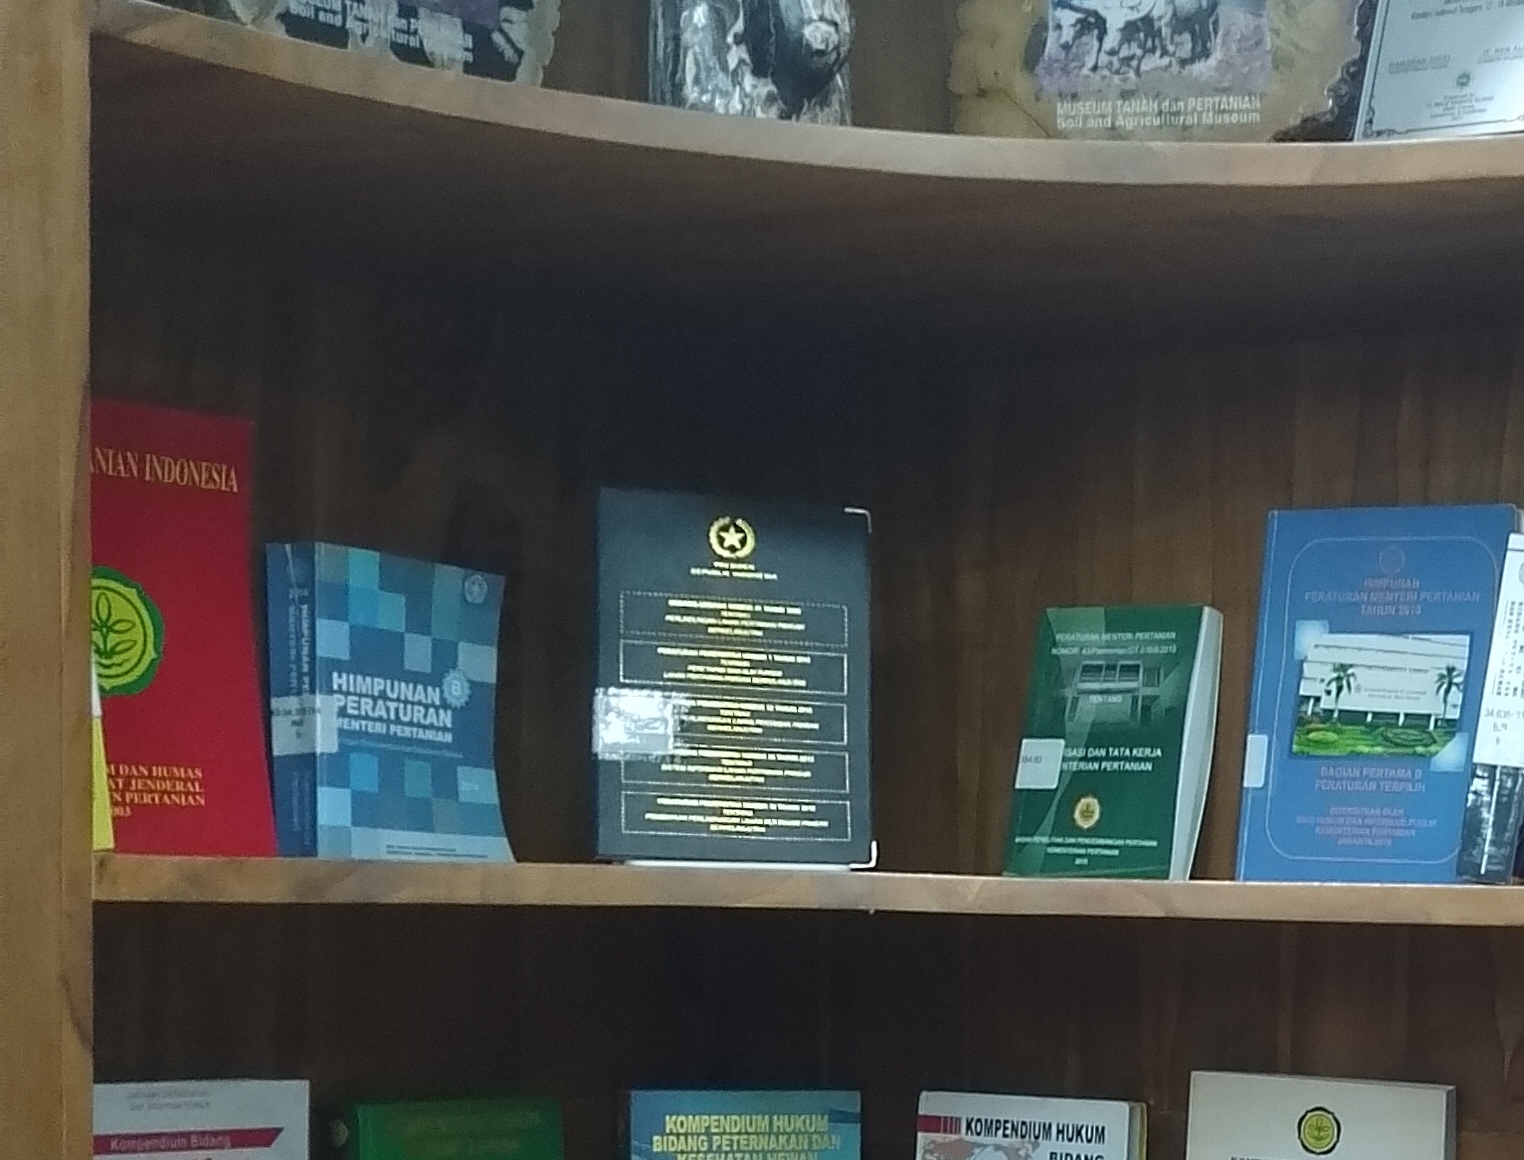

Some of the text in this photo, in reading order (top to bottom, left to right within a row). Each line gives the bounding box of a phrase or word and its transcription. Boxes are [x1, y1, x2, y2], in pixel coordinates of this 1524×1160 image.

[1057, 100, 1112, 116] MUSEUM
[1117, 98, 1158, 114] TANAH
[1187, 93, 1261, 111] PERTANIAN
[1202, 110, 1261, 125] Museum
[144, 452, 239, 493] INDONESIA
[331, 671, 441, 706] HIMPUNAN
[335, 694, 453, 728] PERATURAN
[388, 724, 453, 744] PERTANIAN
[1087, 747, 1162, 759] DAN TATA KERJA
[118, 762, 203, 780] DAN HUMAS
[1101, 760, 1152, 772] PERTANIAN
[125, 791, 206, 808] PERTANIAN
[665, 1113, 830, 1134] KOMPENDIUM HUKUM
[965, 1116, 1106, 1145] KOMPENDIUM HUKUM
[110, 1134, 232, 1151] Kompendium Bidang
[652, 1133, 842, 1152] BIDANG PETERNAKAN DAN
